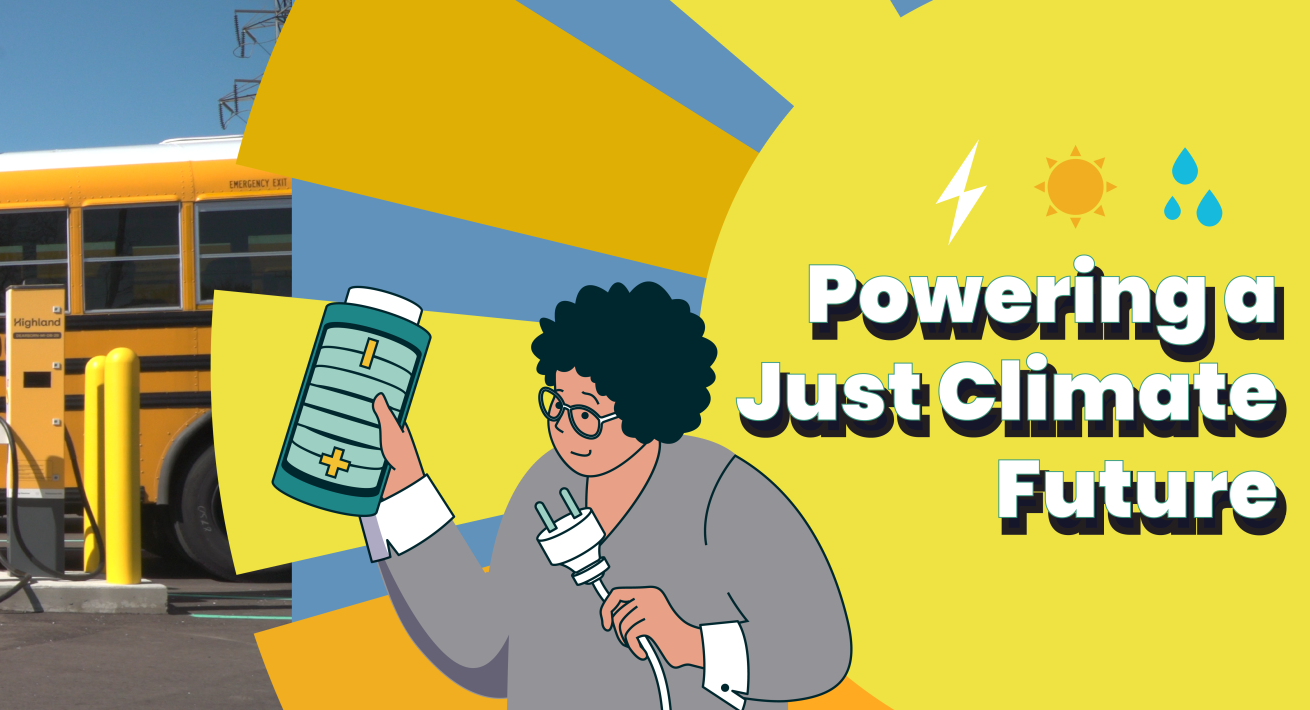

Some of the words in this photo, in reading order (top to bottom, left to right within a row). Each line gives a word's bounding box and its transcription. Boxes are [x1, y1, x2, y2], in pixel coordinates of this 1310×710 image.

[229, 179, 270, 189] EMERGENCY
[272, 177, 288, 188] EXIT
[13, 317, 61, 329] Highland
